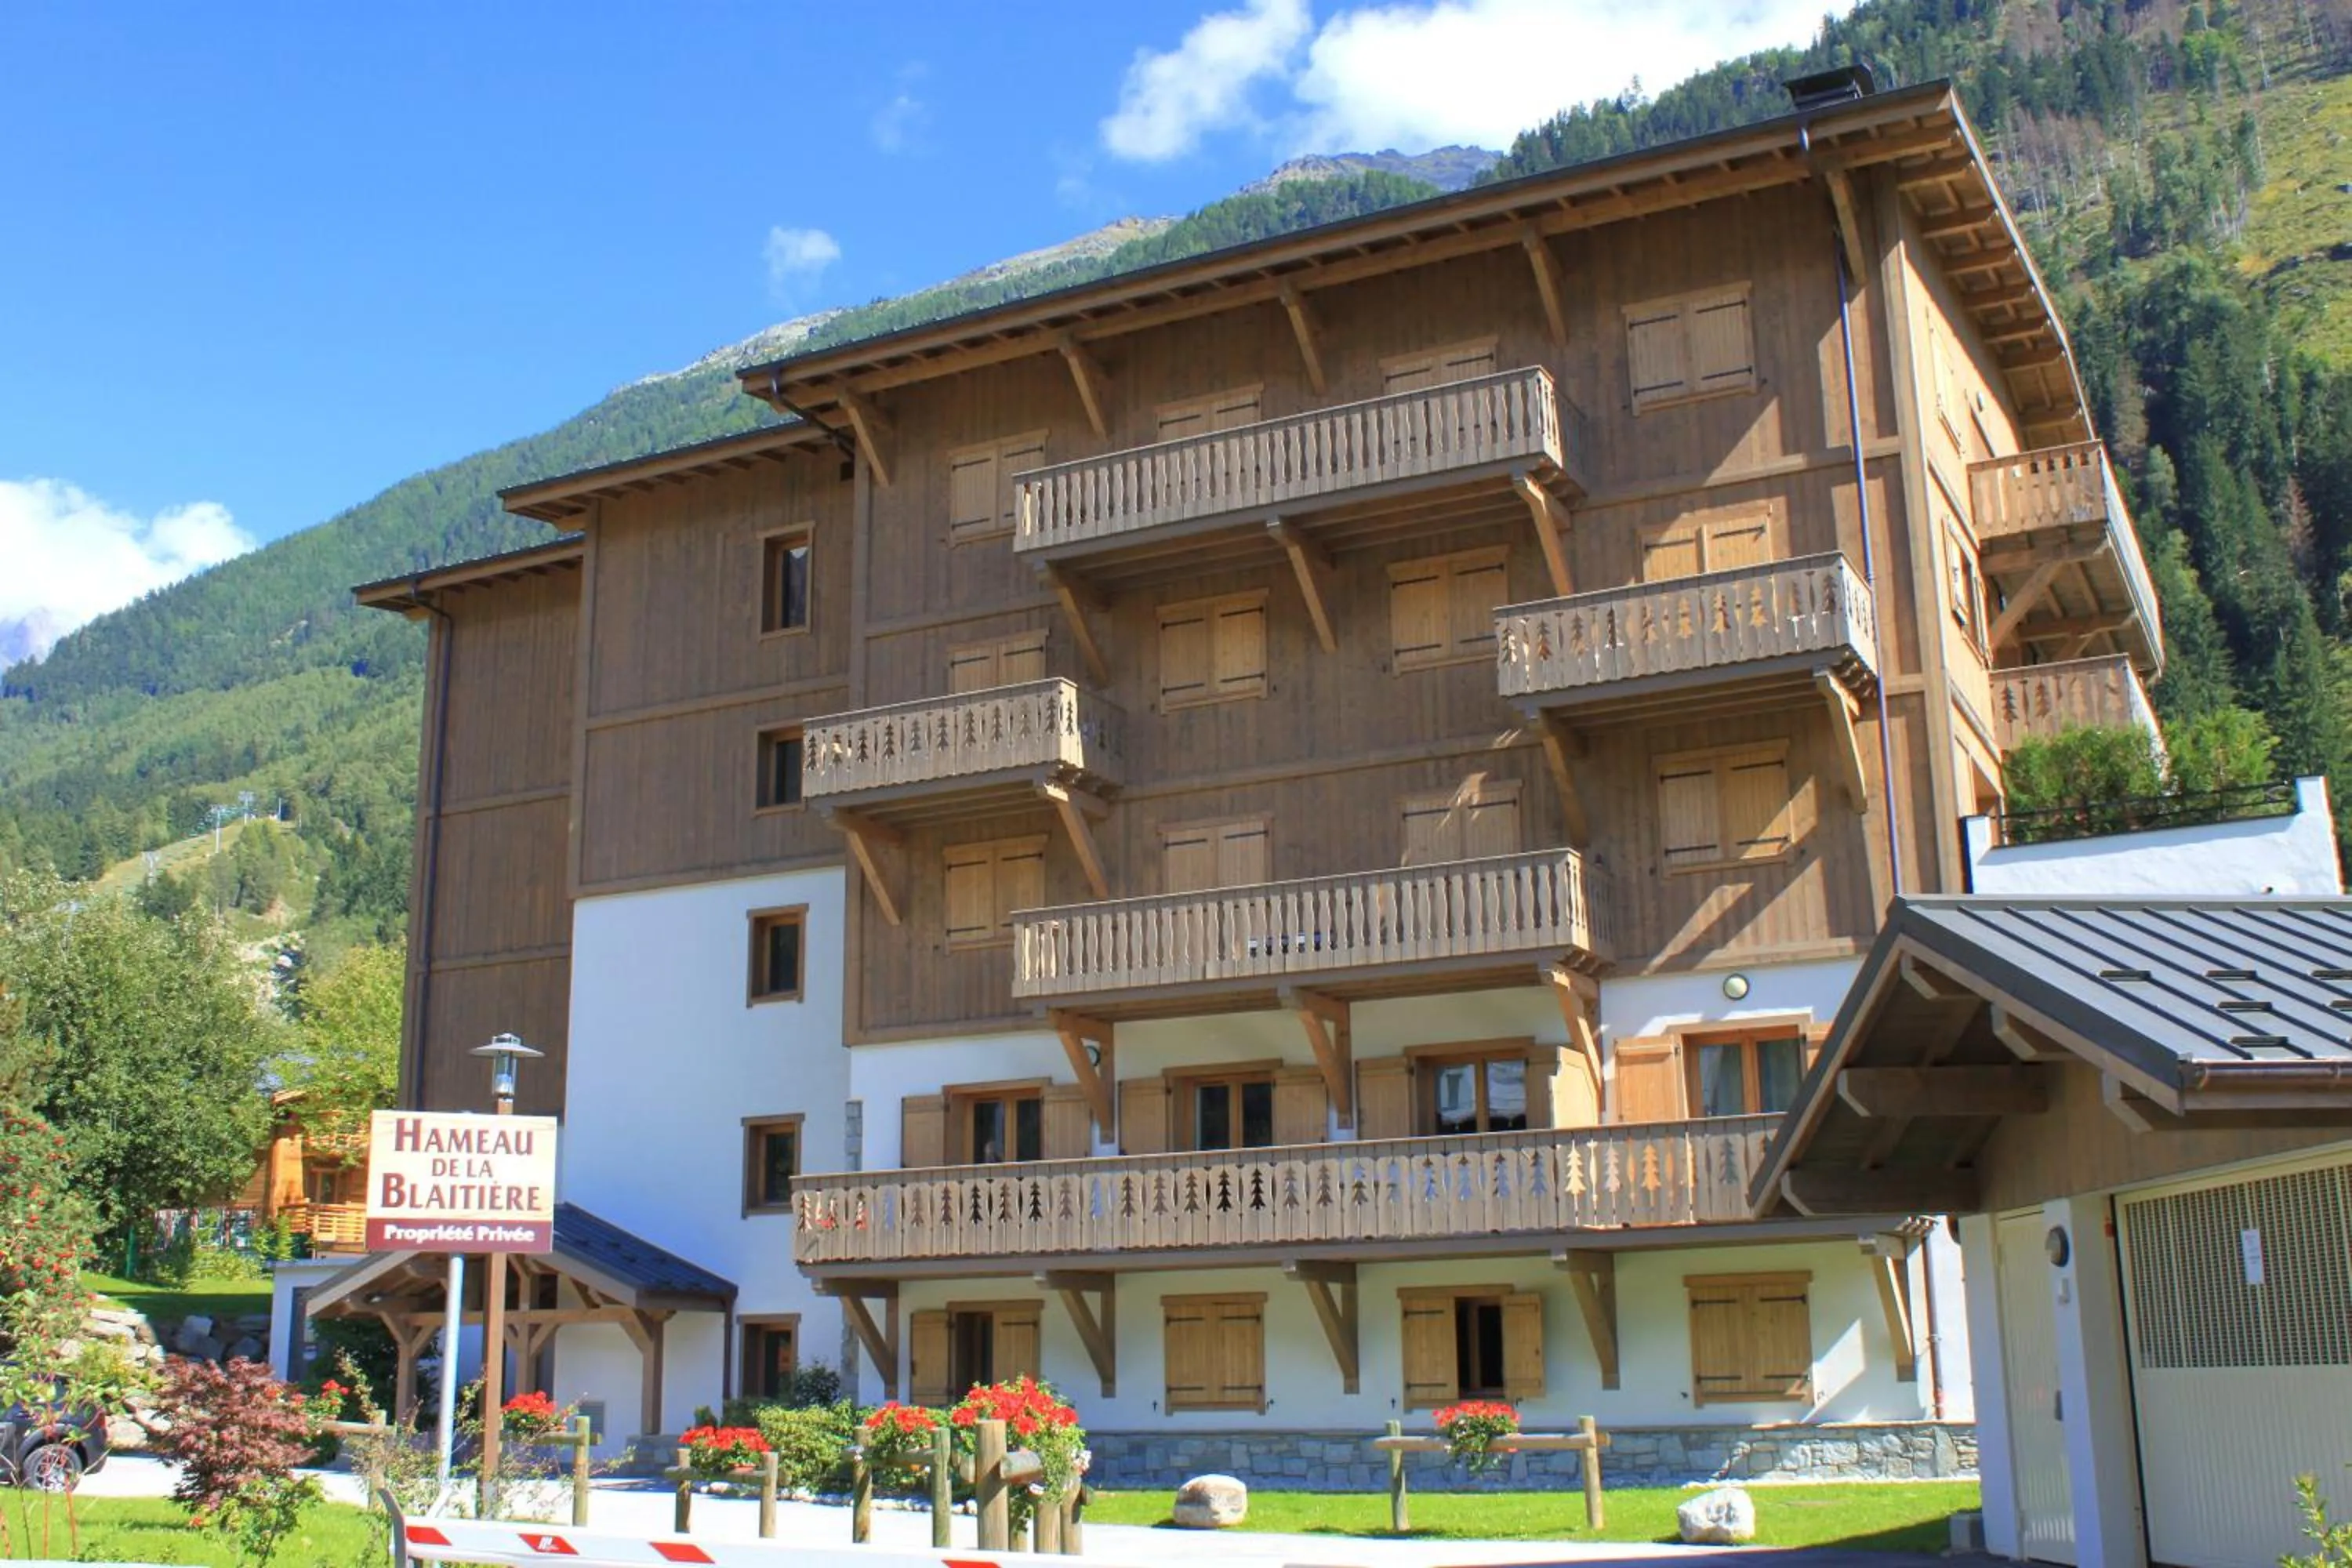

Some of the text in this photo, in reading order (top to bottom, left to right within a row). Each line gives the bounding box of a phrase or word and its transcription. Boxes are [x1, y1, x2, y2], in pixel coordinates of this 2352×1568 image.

[394, 1118, 534, 1156] HAMEAU
[431, 1158, 494, 1178] DE LA
[384, 1225, 535, 1243] Propriété Privée
